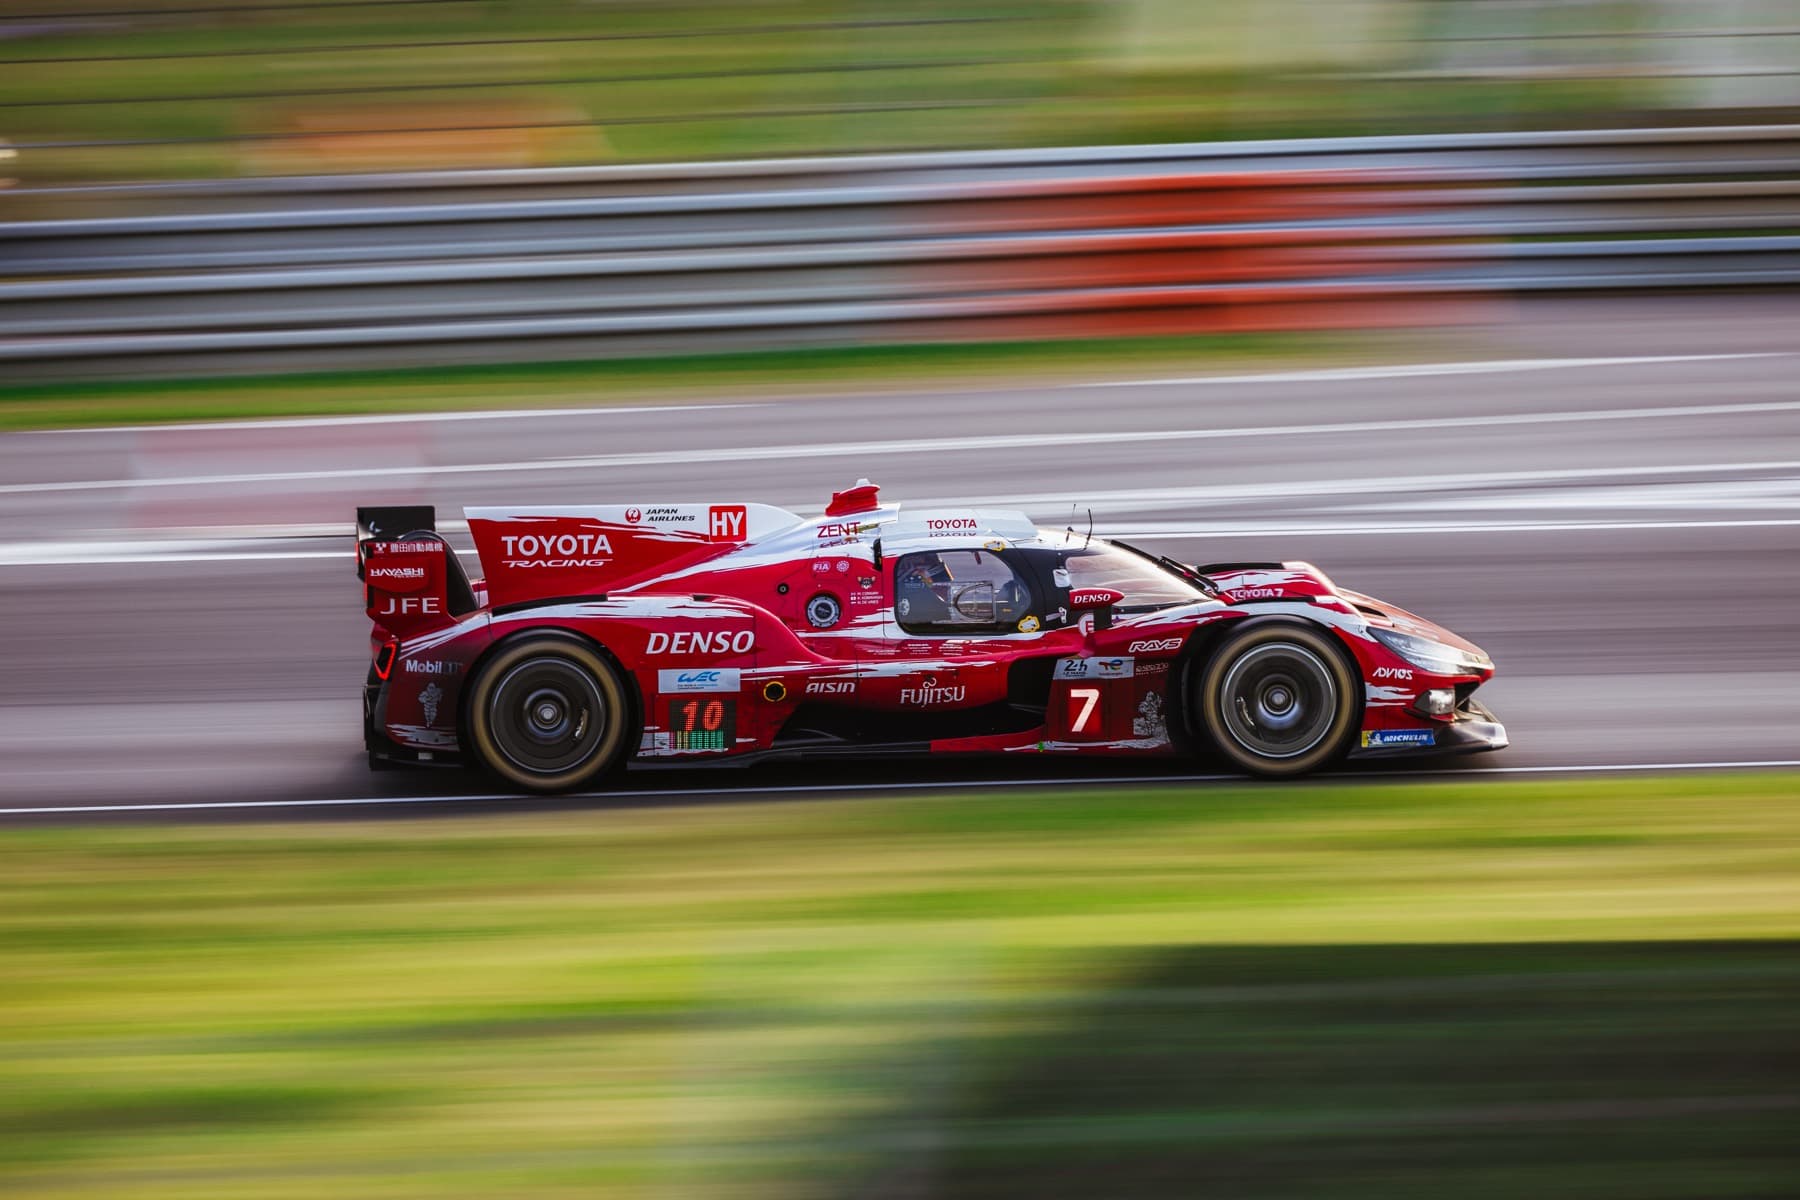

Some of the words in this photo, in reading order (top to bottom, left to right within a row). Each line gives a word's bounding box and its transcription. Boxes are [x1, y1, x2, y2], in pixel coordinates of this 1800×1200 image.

[711, 511, 744, 537] HY
[817, 522, 861, 538] ZENT
[927, 519, 978, 529] TOYOTA
[501, 534, 613, 556] TOYOTA
[502, 559, 613, 567] RACING
[813, 563, 829, 571] FIA
[370, 568, 424, 577] HAYASHI
[1074, 593, 1111, 603] DENSO
[1231, 589, 1274, 598] TOYOTA
[1274, 588, 1284, 597] 7
[380, 597, 440, 615] JFE
[646, 630, 755, 654] DENSO
[1128, 638, 1183, 653] RAYS
[406, 660, 442, 673] Mobil
[678, 671, 721, 682] WEC
[1372, 667, 1413, 680] ADVICS
[805, 682, 855, 693] AISIN
[900, 686, 965, 707] FUJITSU
[682, 701, 723, 731] 10
[1070, 688, 1099, 732] 7
[1383, 734, 1428, 742] MICHELIN
